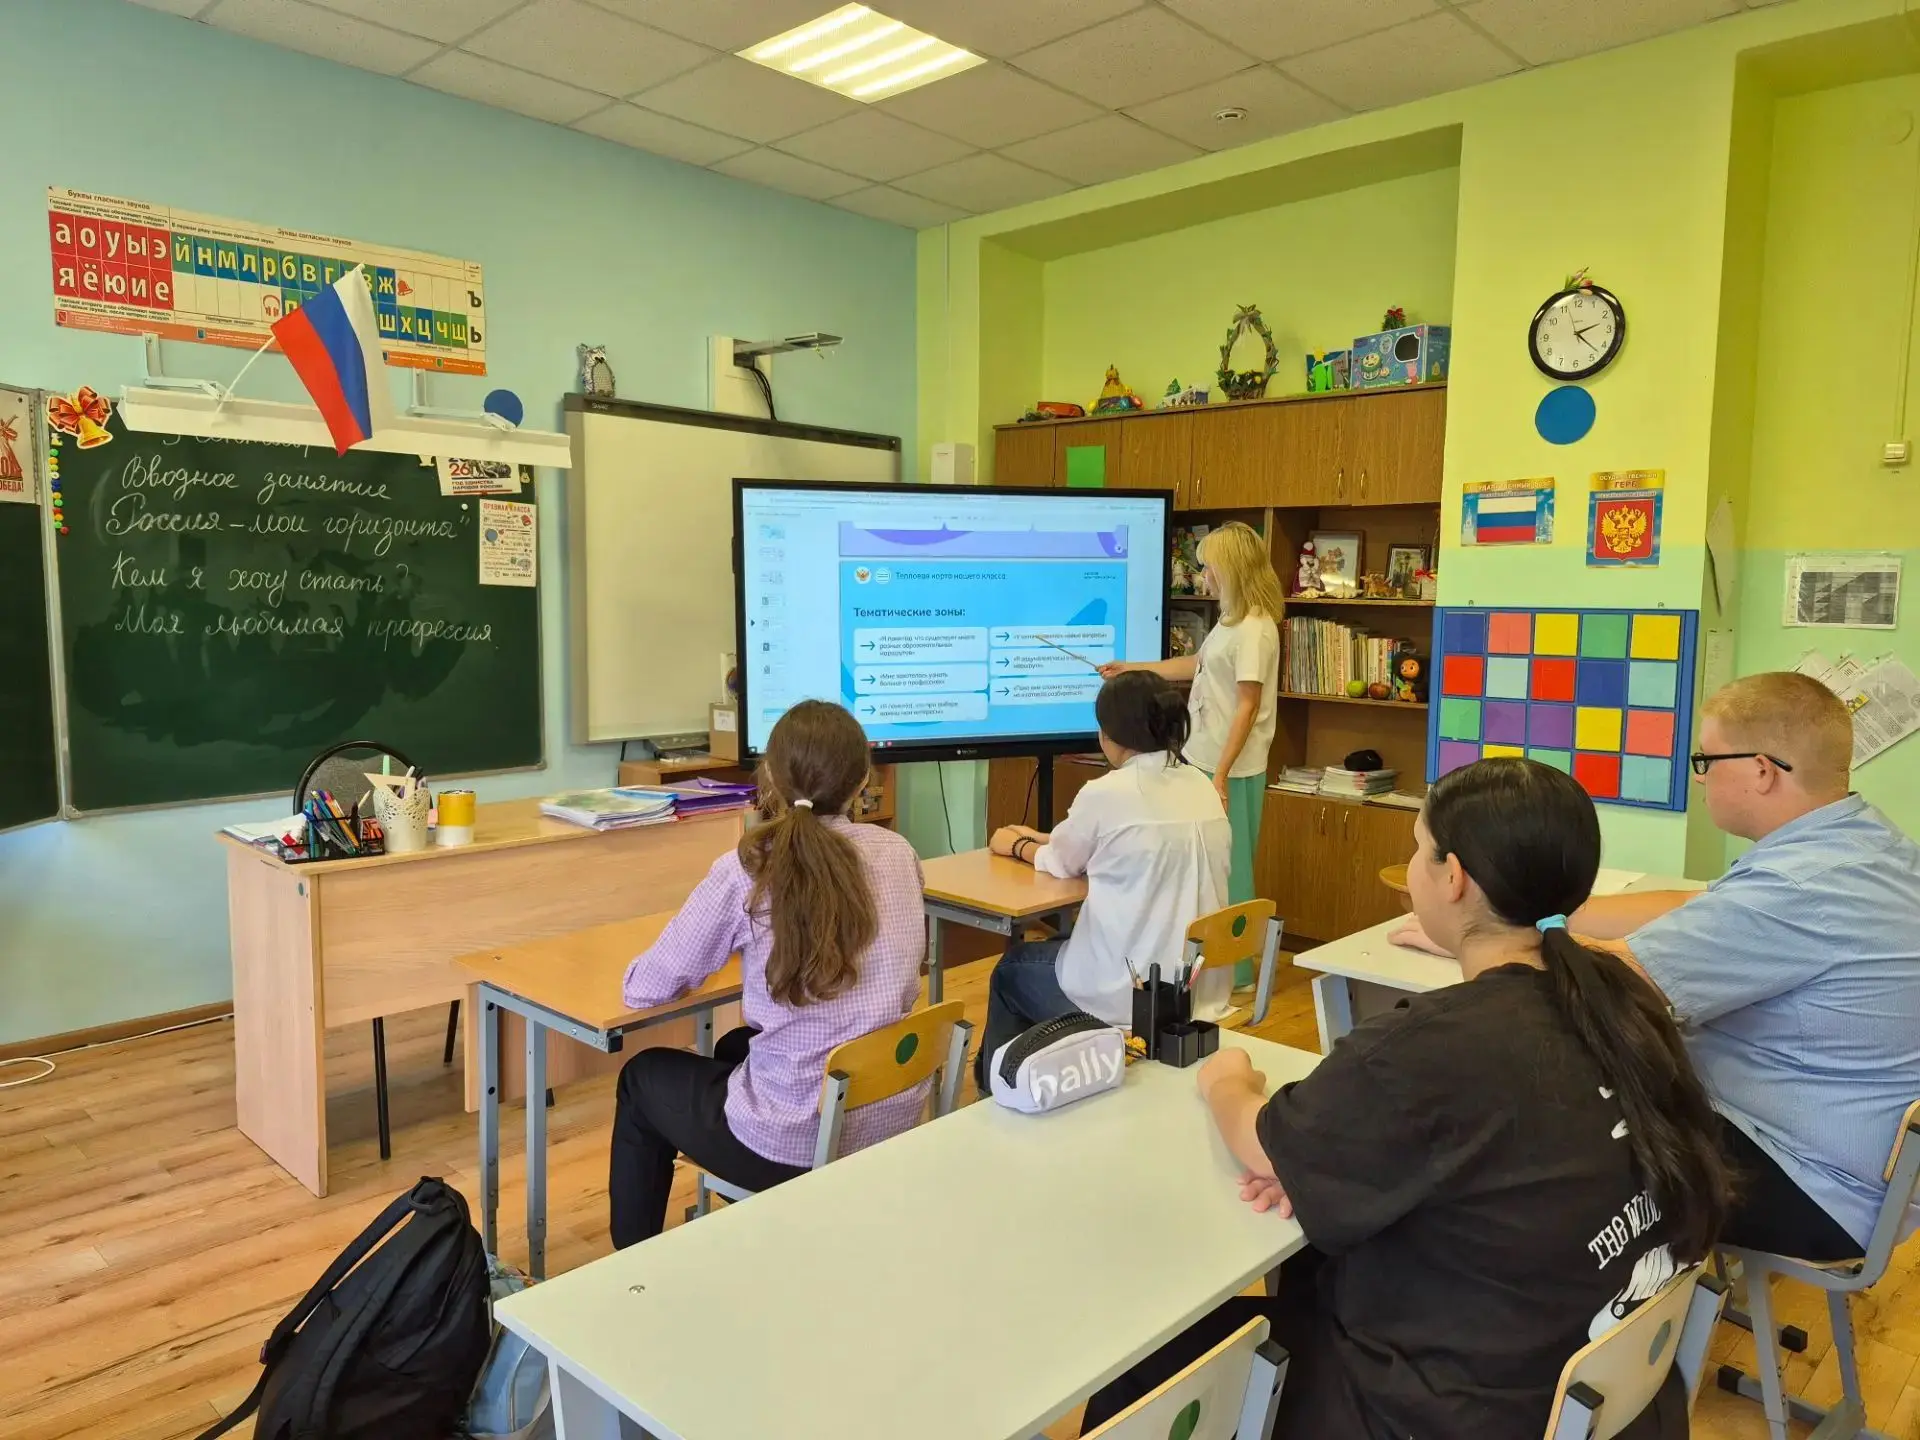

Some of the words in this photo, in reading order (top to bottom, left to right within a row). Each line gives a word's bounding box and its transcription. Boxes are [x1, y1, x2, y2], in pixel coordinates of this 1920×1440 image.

[1574, 300, 1583, 308] 12
[1560, 306, 1568, 314] 11
[1602, 310, 1608, 319] 2
[1550, 318, 1558, 326] 10
[1606, 326, 1612, 334] 3
[1543, 334, 1550, 342] 9
[1602, 340, 1607, 348] 4
[1546, 348, 1552, 356] 8
[1559, 358, 1564, 366] 7
[1588, 354, 1595, 362] 5
[1572, 360, 1578, 368] 6
[448, 462, 470, 476] 26
[121, 454, 240, 501] Вводное
[256, 472, 392, 505] занятие
[112, 550, 169, 590] Кем
[186, 566, 206, 590] я
[228, 568, 288, 609] хочу
[853, 607, 932, 617] Тематические
[935, 608, 966, 616] зоны:
[114, 604, 185, 634] Моя
[205, 610, 345, 638] любимая
[1588, 1216, 1628, 1270] THE
